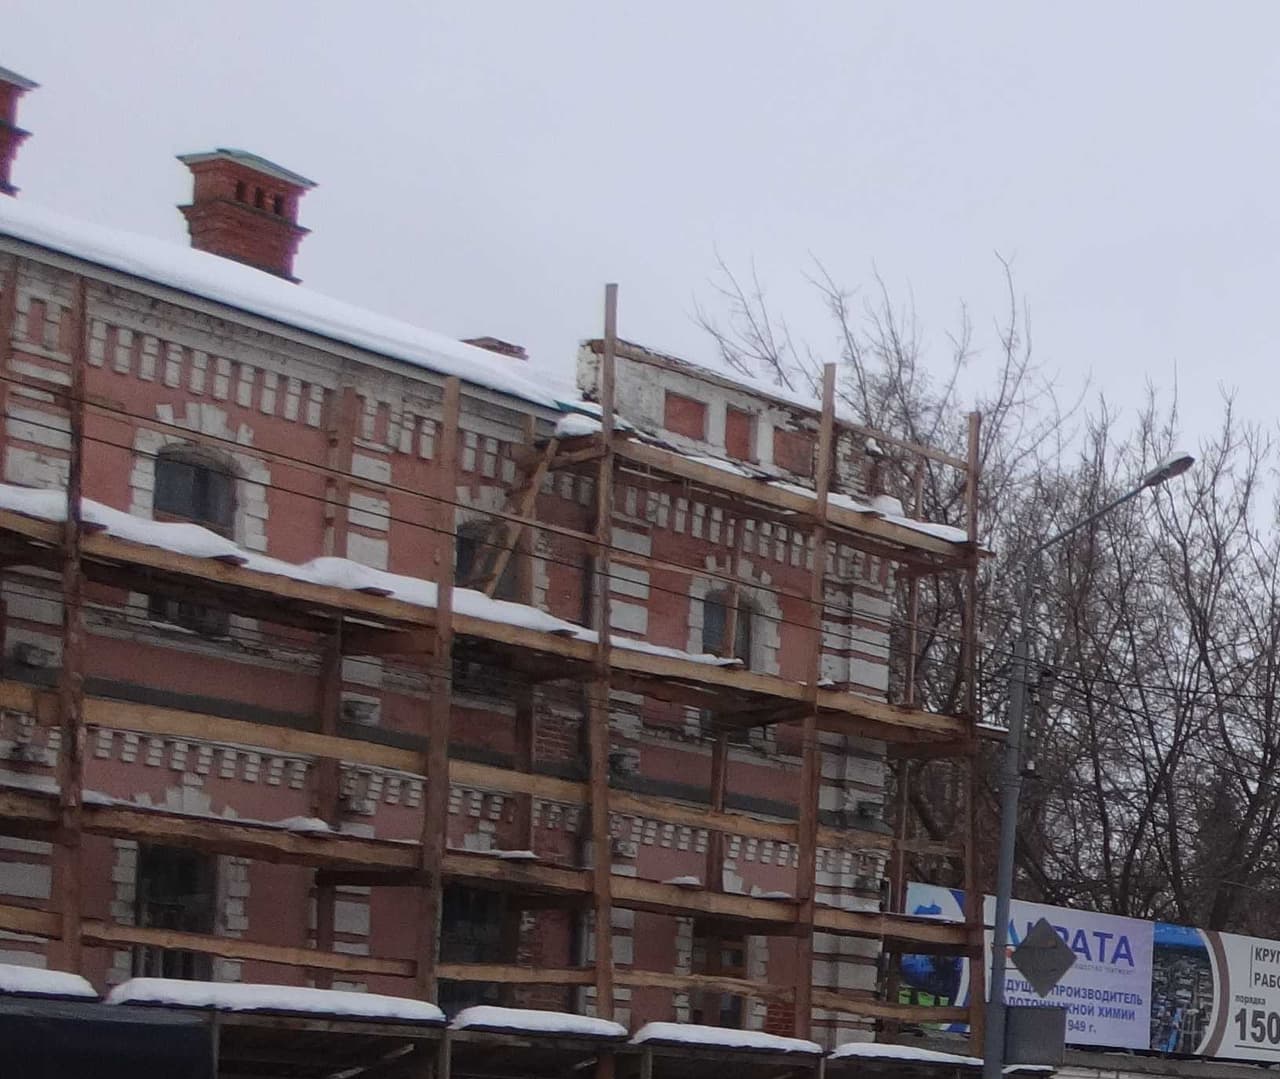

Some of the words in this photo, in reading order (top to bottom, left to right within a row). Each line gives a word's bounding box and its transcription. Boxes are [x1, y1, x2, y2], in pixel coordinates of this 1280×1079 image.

[1051, 985, 1143, 1005] ПРОИЗВОДИТЕЛЬ
[1235, 995, 1266, 1005] порядка
[1098, 1007, 1135, 1021] ХИМИИ
